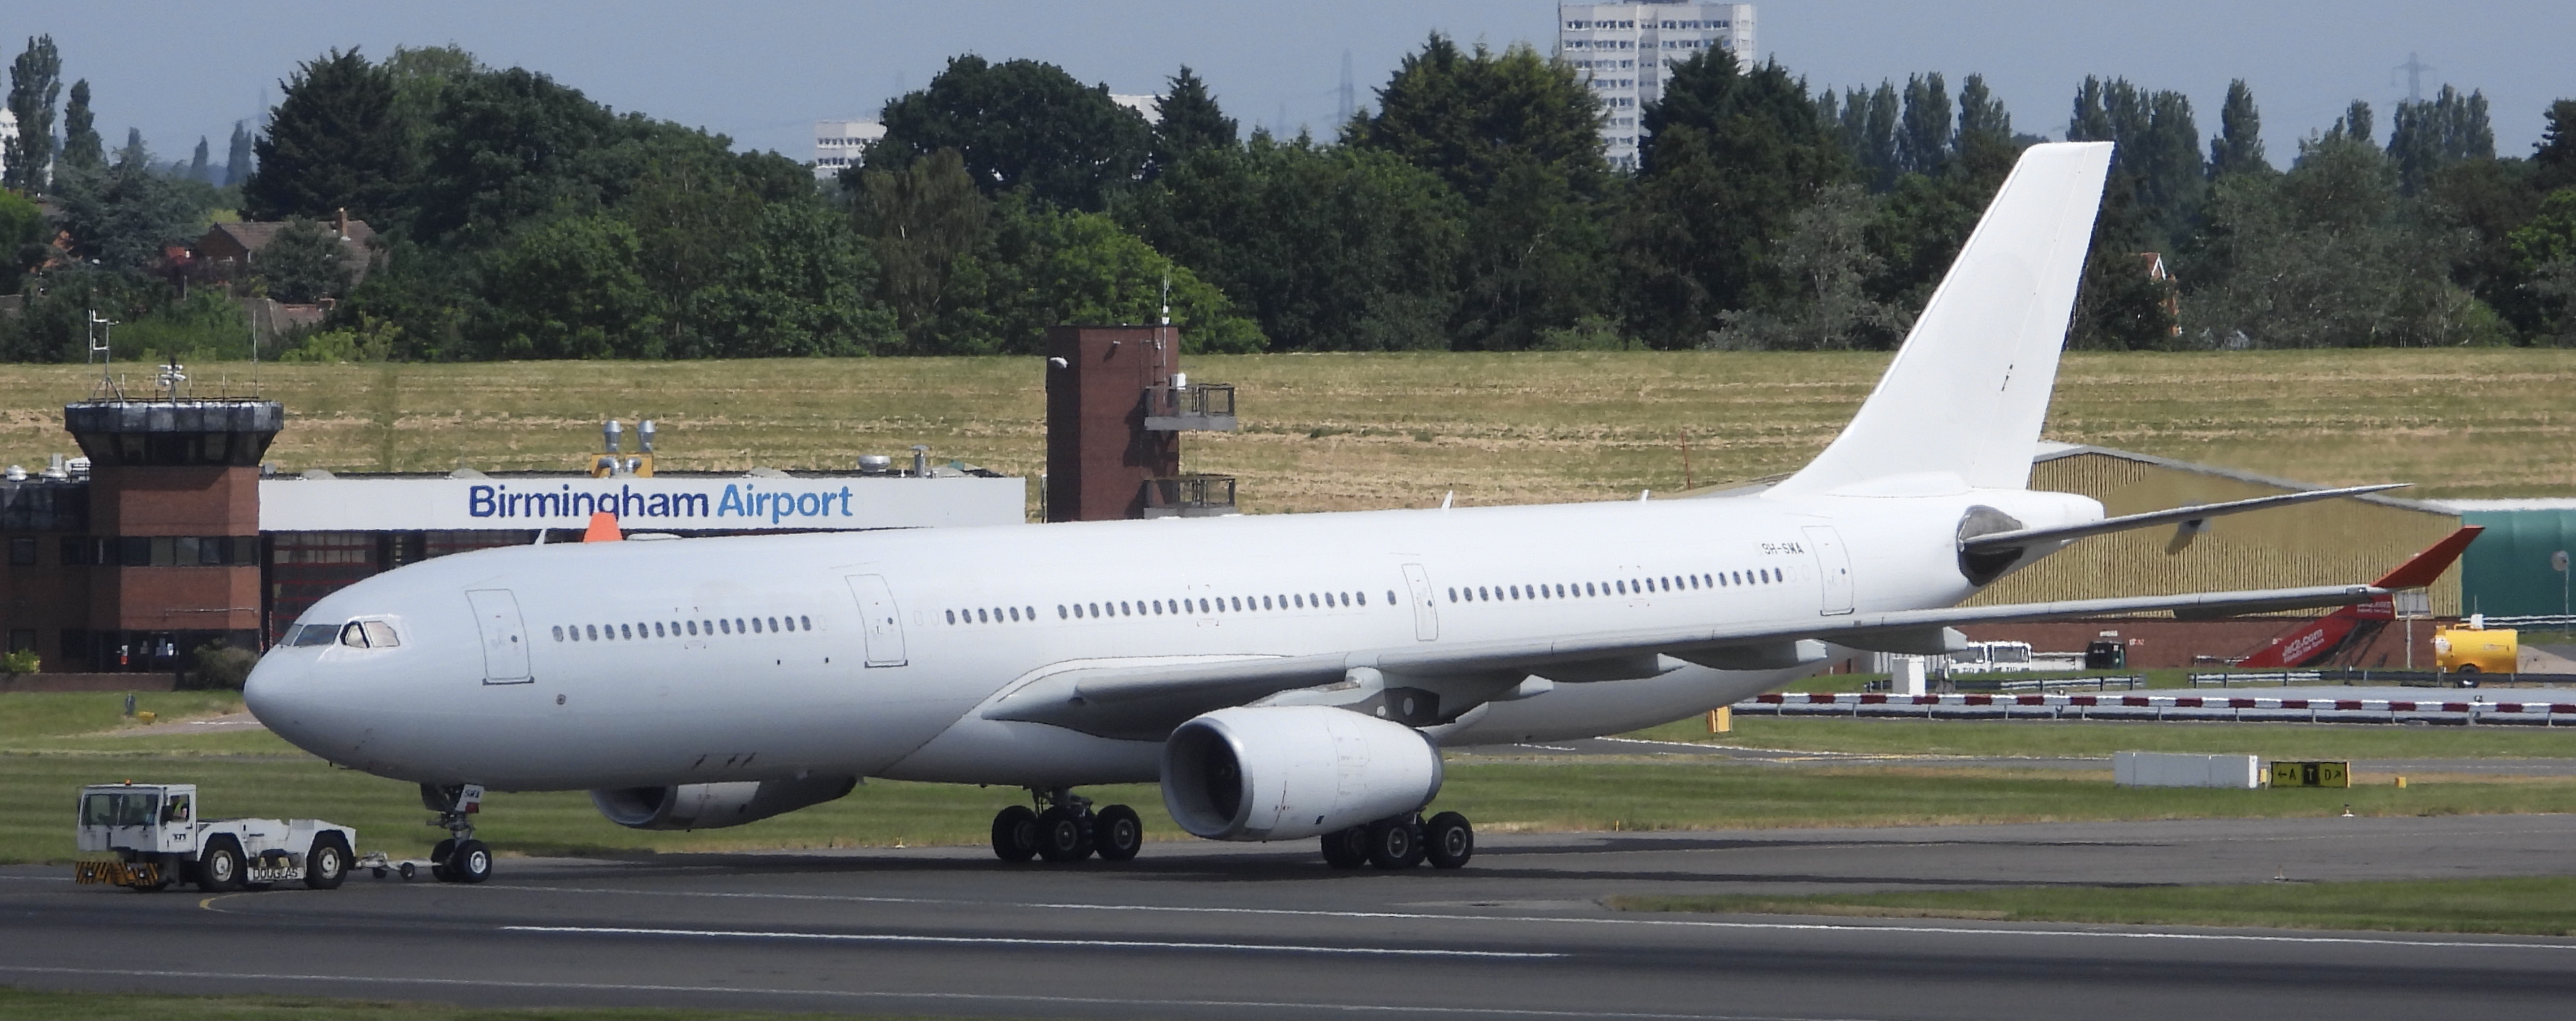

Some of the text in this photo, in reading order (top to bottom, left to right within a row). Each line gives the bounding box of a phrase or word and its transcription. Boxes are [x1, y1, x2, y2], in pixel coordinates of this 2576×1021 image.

[469, 484, 853, 524] Birmingham Airport
[2289, 768, 2331, 781] A T D
[253, 867, 298, 879] DOUGLAS
